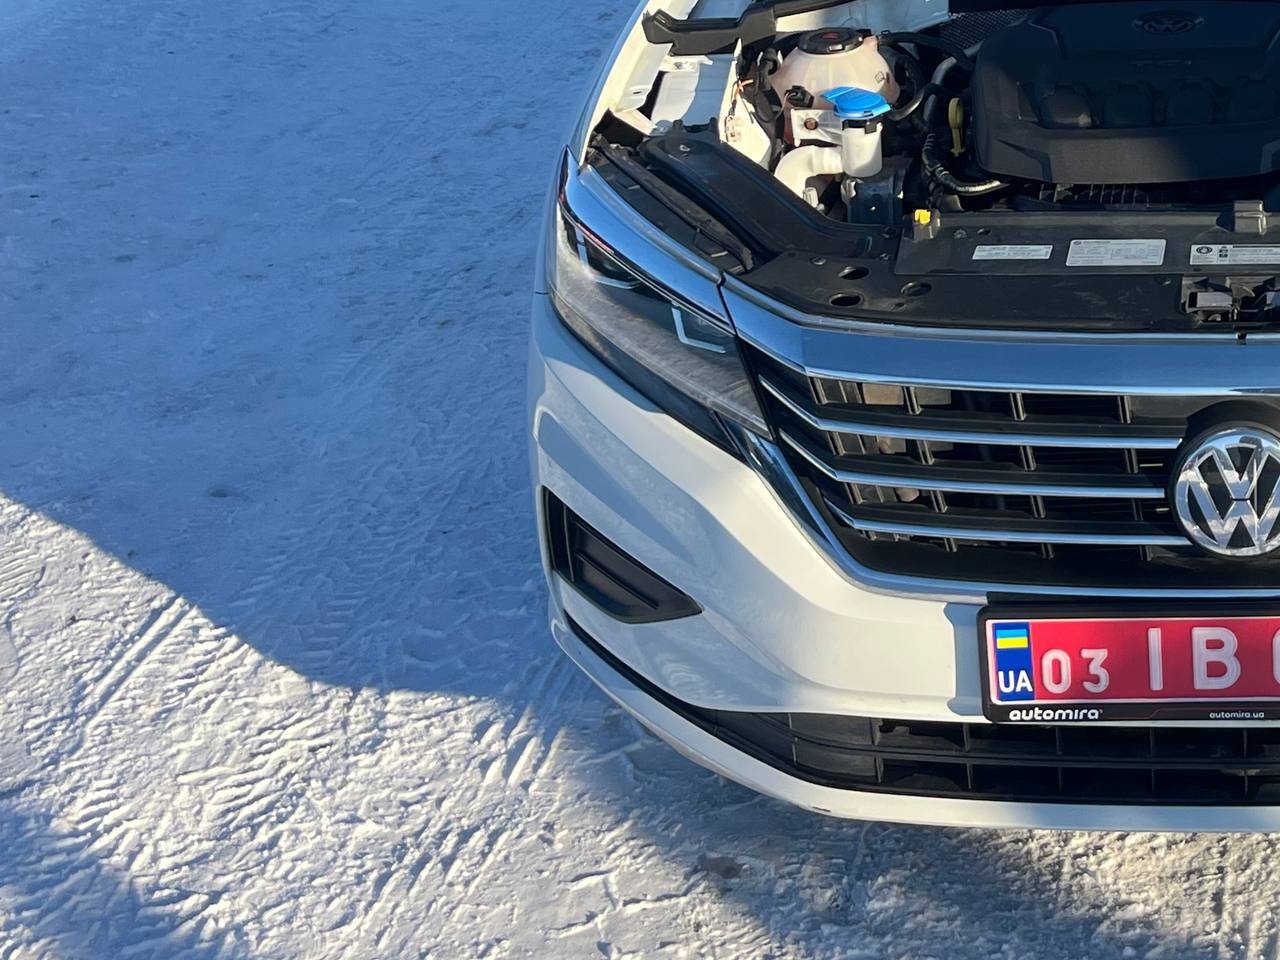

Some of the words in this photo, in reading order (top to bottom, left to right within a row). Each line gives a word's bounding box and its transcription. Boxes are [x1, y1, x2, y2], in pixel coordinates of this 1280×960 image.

[998, 669, 1033, 693] UA
[1041, 648, 1110, 694] 03
[1008, 706, 1100, 721] automira
[1208, 710, 1266, 719] automira.ua
